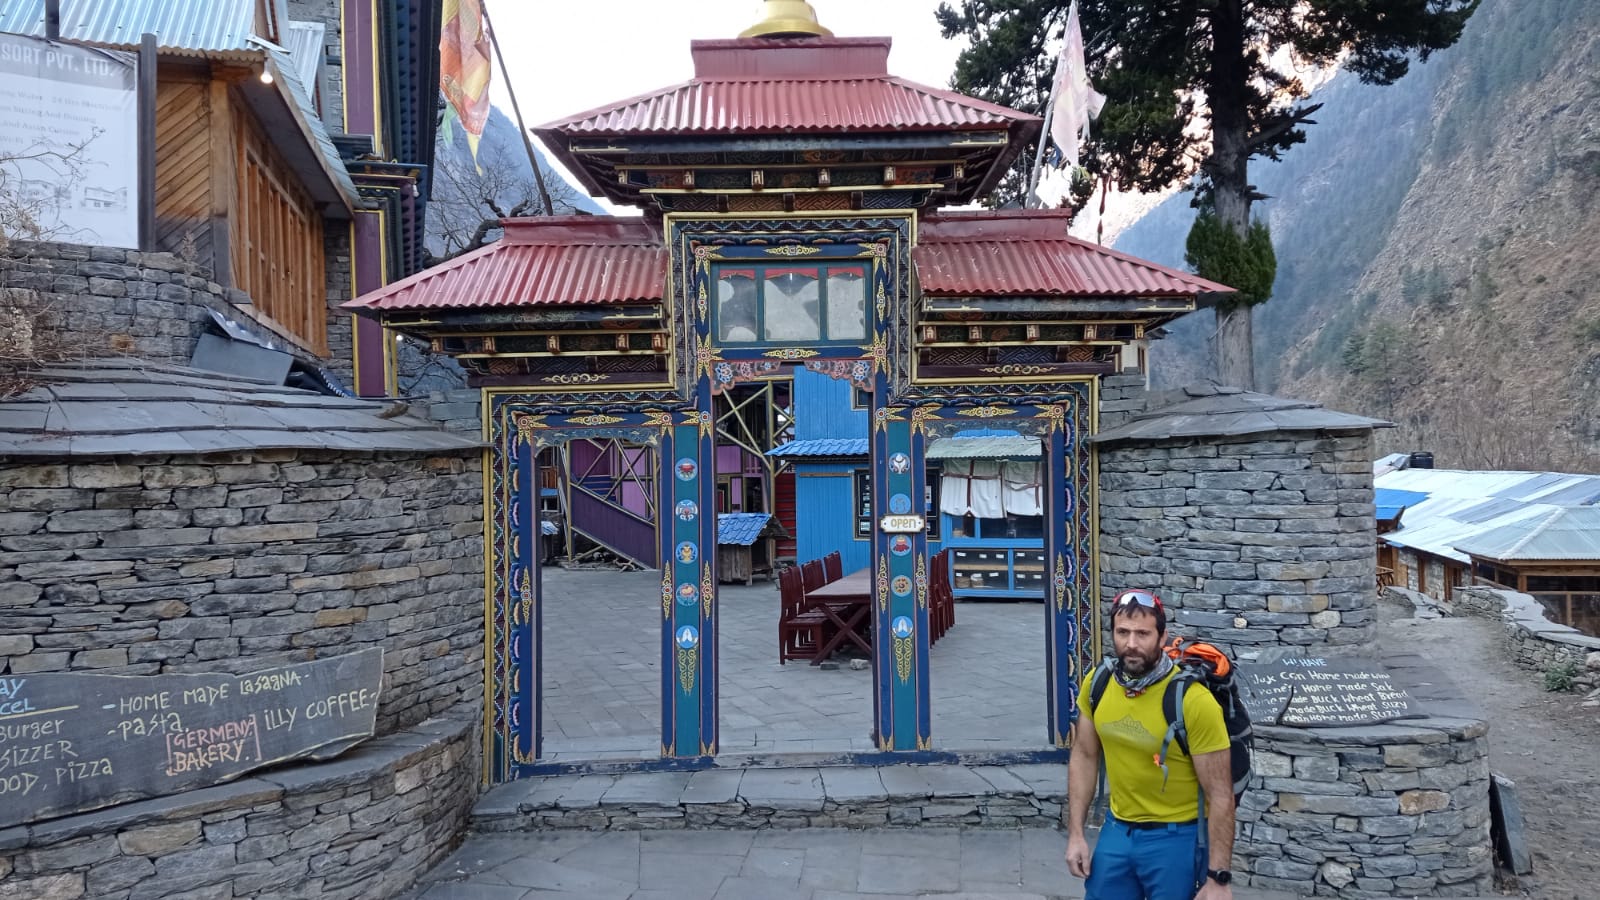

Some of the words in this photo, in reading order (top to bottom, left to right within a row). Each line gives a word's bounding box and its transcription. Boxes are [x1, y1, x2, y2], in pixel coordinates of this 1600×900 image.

[46, 51, 79, 72] PVT.
[84, 57, 115, 77] LTD.
[1299, 658, 1328, 667] HAVE
[1307, 670, 1340, 680] Home
[1343, 671, 1370, 680] made
[1301, 684, 1332, 693] Home
[1336, 682, 1368, 691] made
